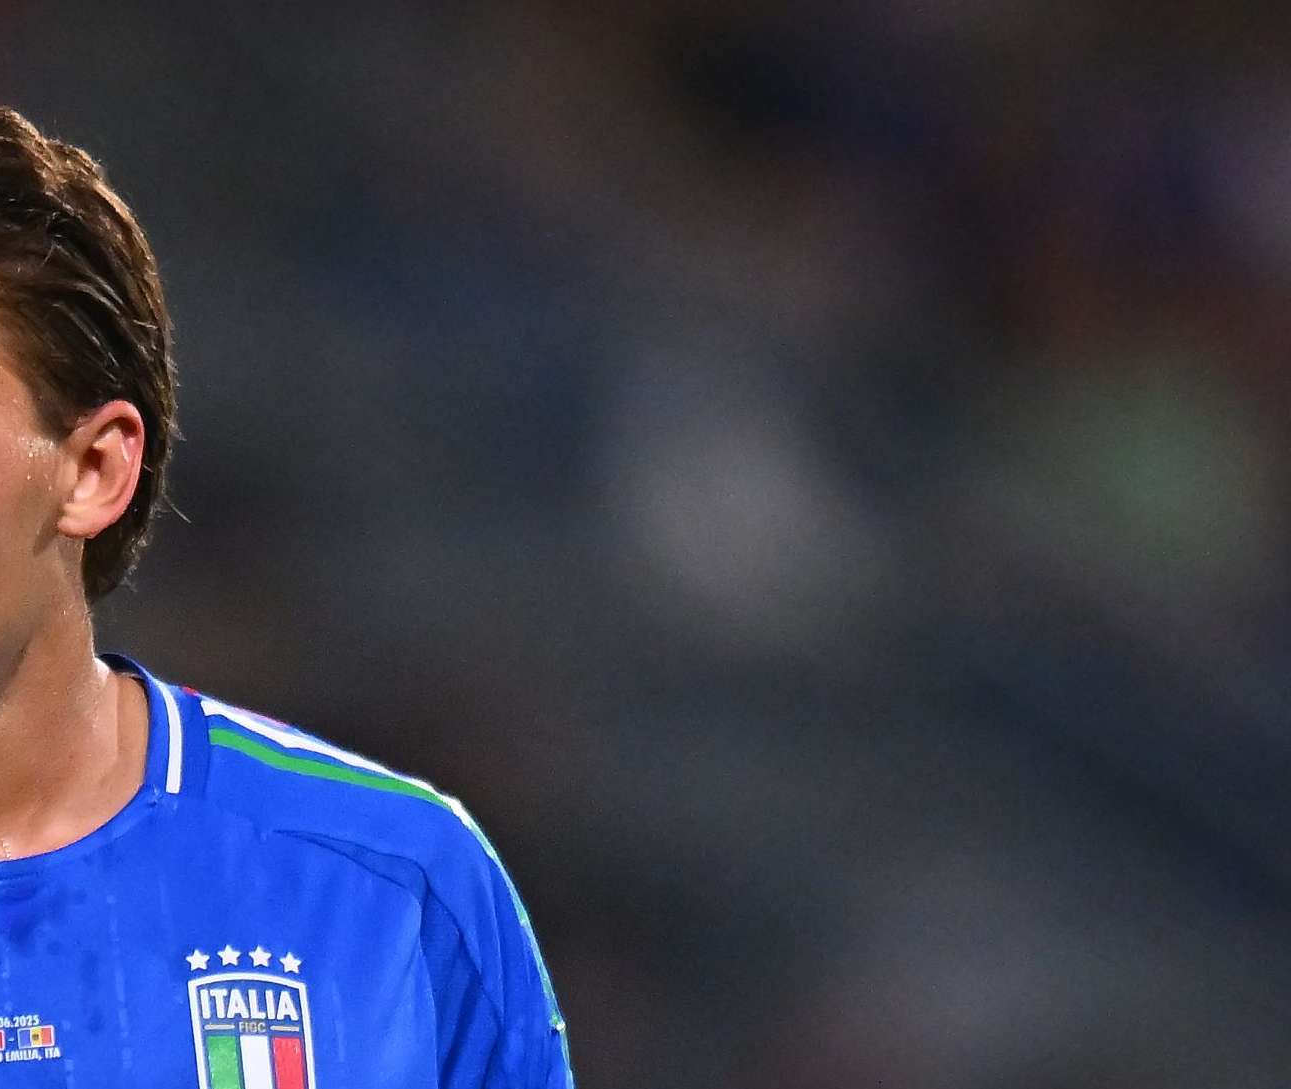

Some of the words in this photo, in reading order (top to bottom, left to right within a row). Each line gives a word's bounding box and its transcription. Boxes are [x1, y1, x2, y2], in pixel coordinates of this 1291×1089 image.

[199, 988, 299, 1021] ITALIA
[6, 1049, 42, 1061] EMILIA,
[45, 1048, 61, 1059] ITA
